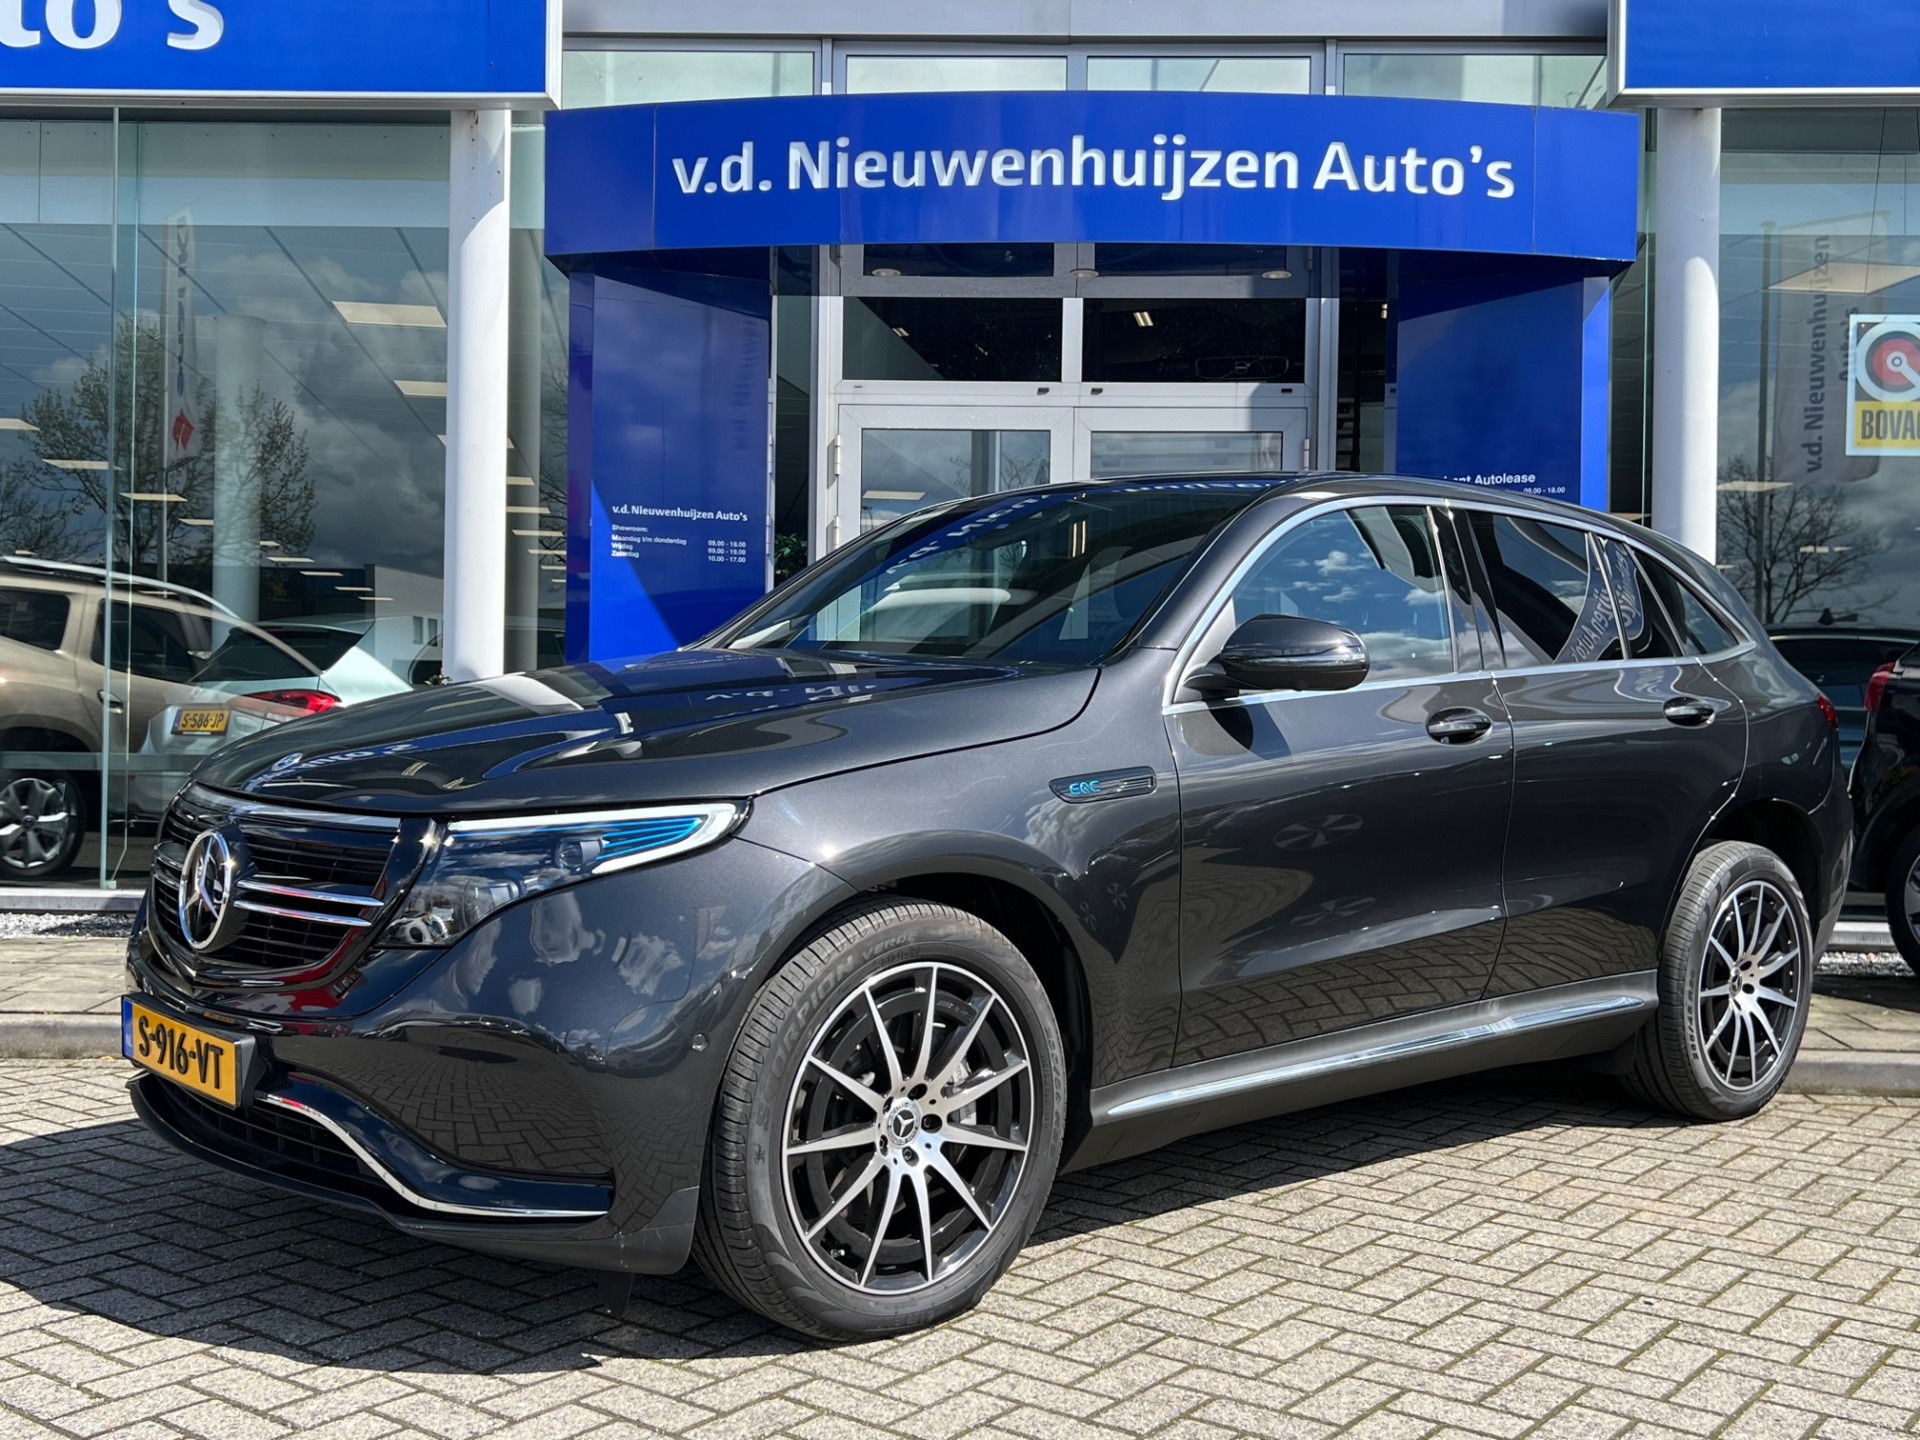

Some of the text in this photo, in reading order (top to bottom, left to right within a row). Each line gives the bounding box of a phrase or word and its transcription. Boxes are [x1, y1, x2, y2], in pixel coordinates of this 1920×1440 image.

[672, 134, 1515, 201] v.d. Nieuwenhuijzen Auto's
[1474, 473, 1537, 485] Autolease
[612, 504, 748, 522] v.d. Nieuwenhuijzen Auto's
[181, 712, 226, 728] S-586-JP
[1069, 779, 1101, 796] EQC
[138, 1014, 224, 1090] S-916-VT
